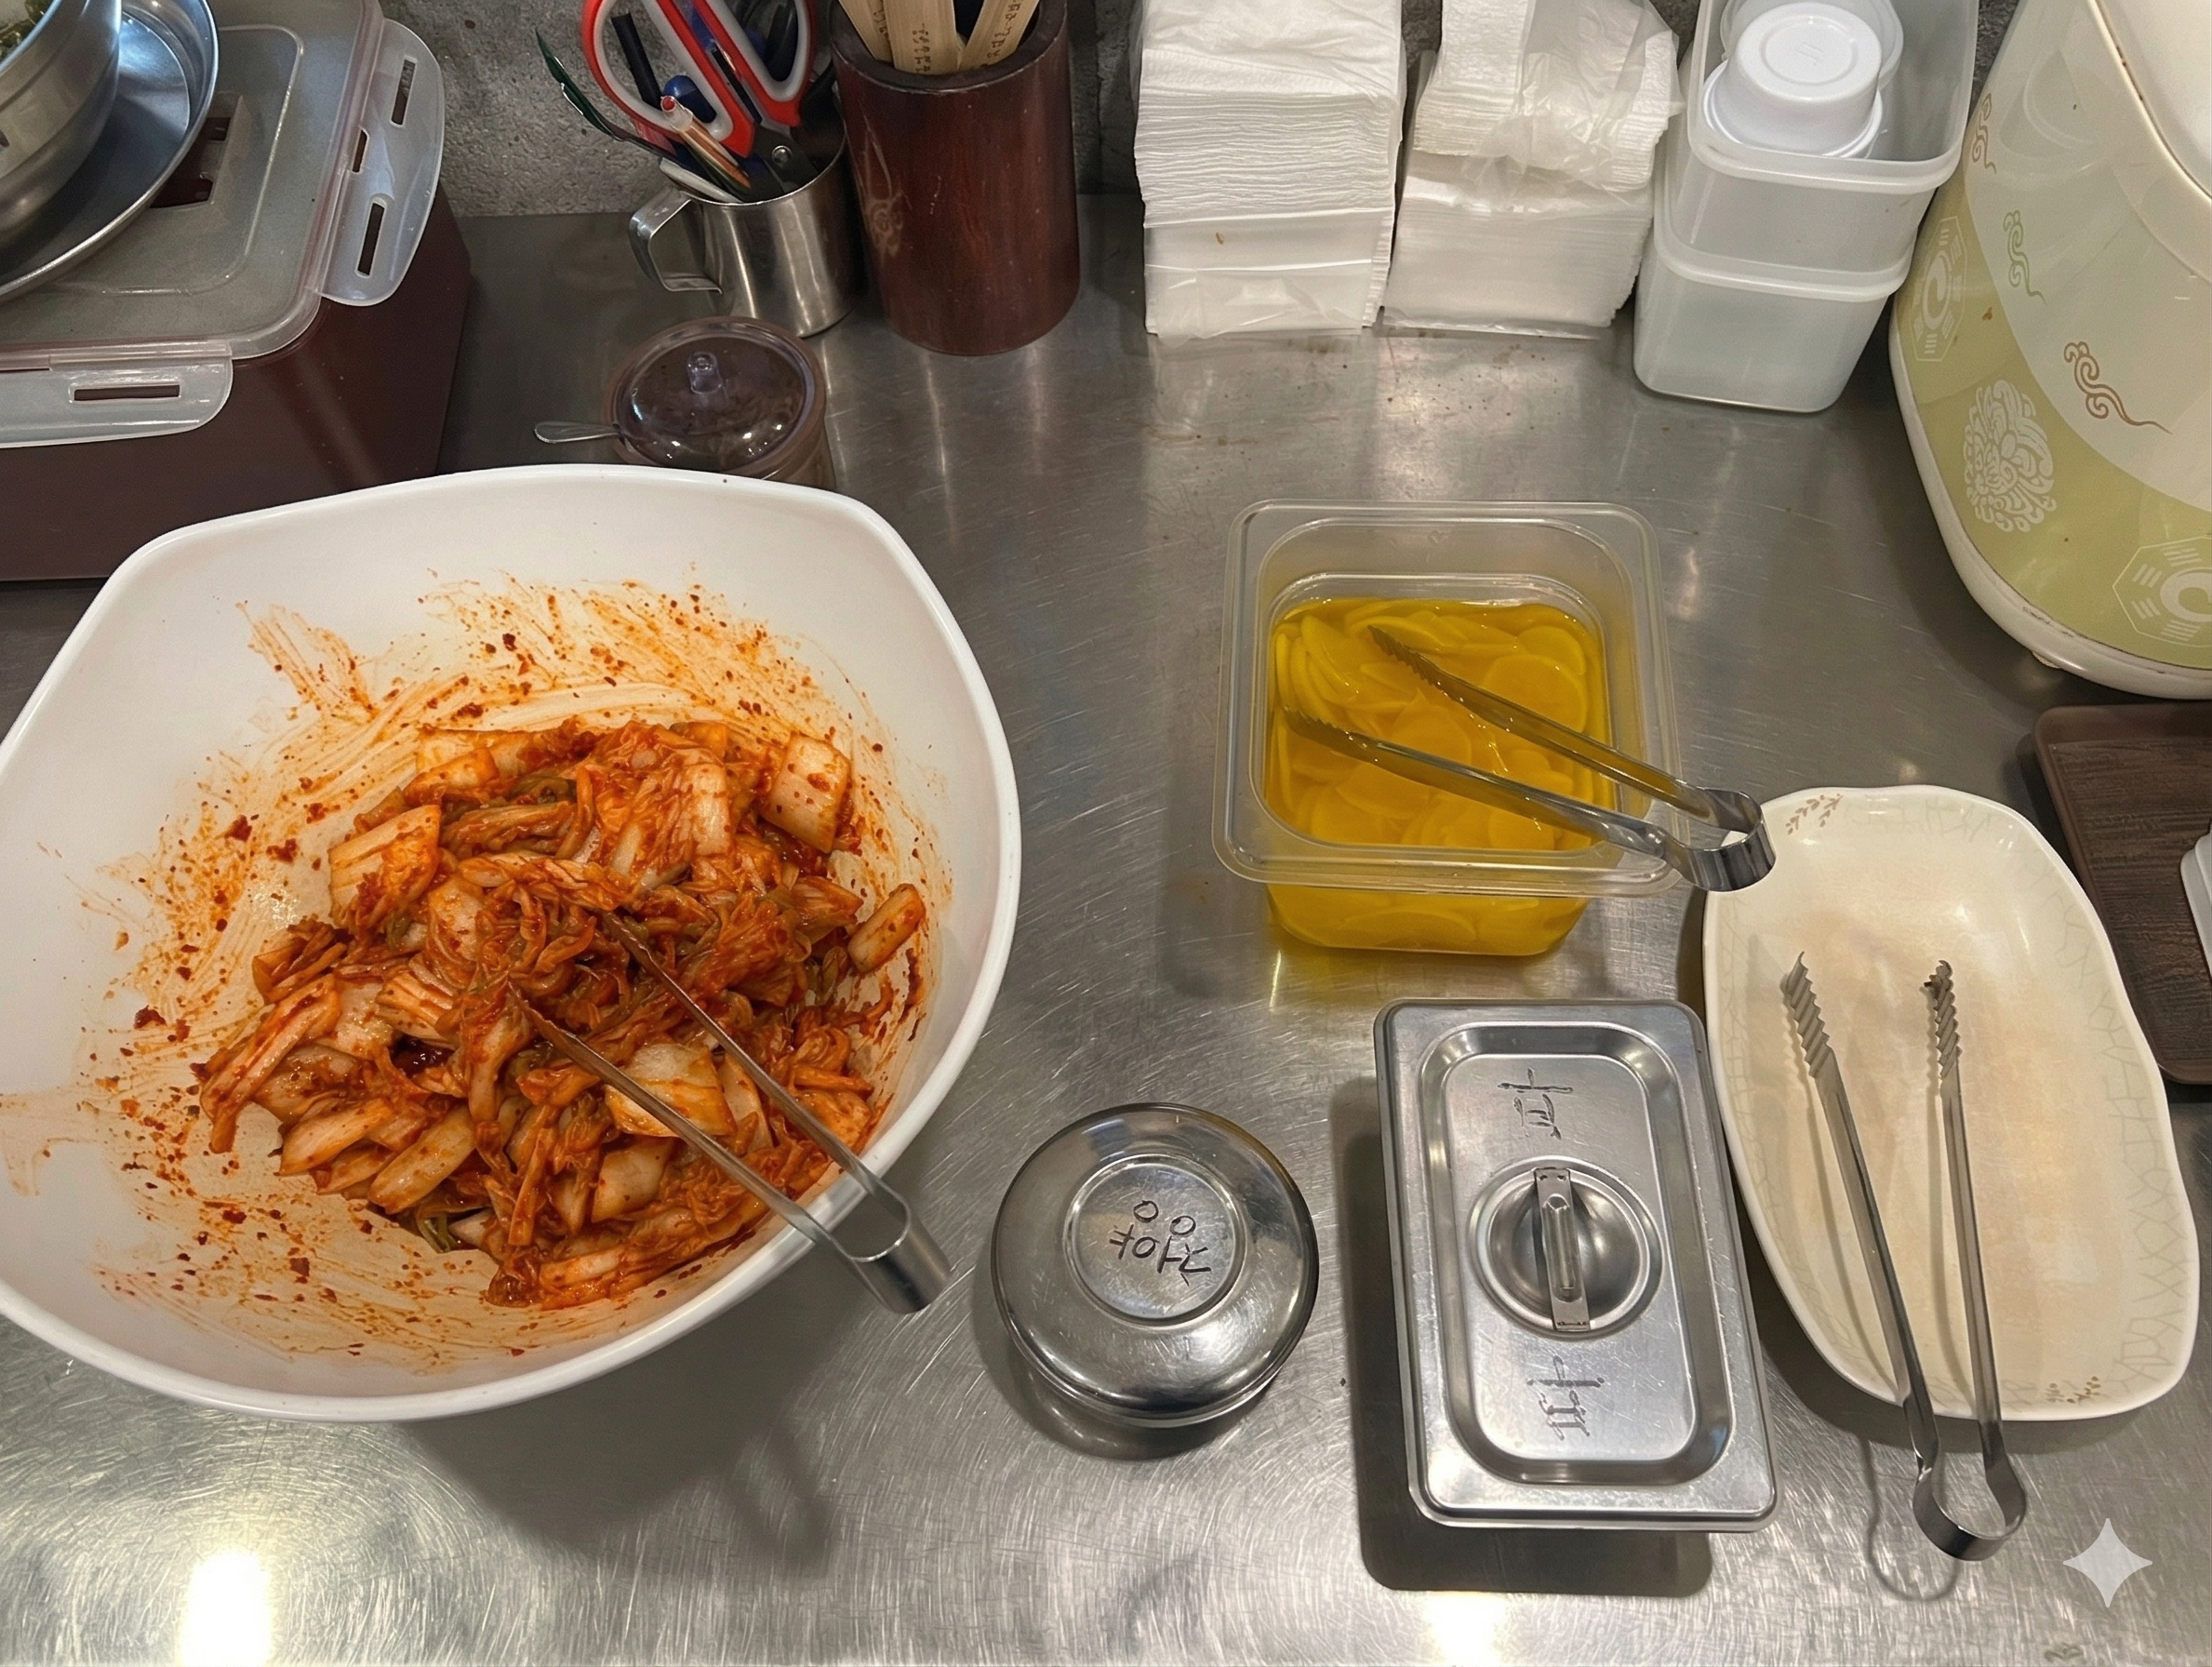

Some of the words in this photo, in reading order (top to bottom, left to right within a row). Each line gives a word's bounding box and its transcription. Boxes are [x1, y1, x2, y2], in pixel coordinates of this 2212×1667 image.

[1498, 1068, 1573, 1140] 파
[1109, 1199, 1212, 1287] 청양
[1526, 1354, 1606, 1441] 파
